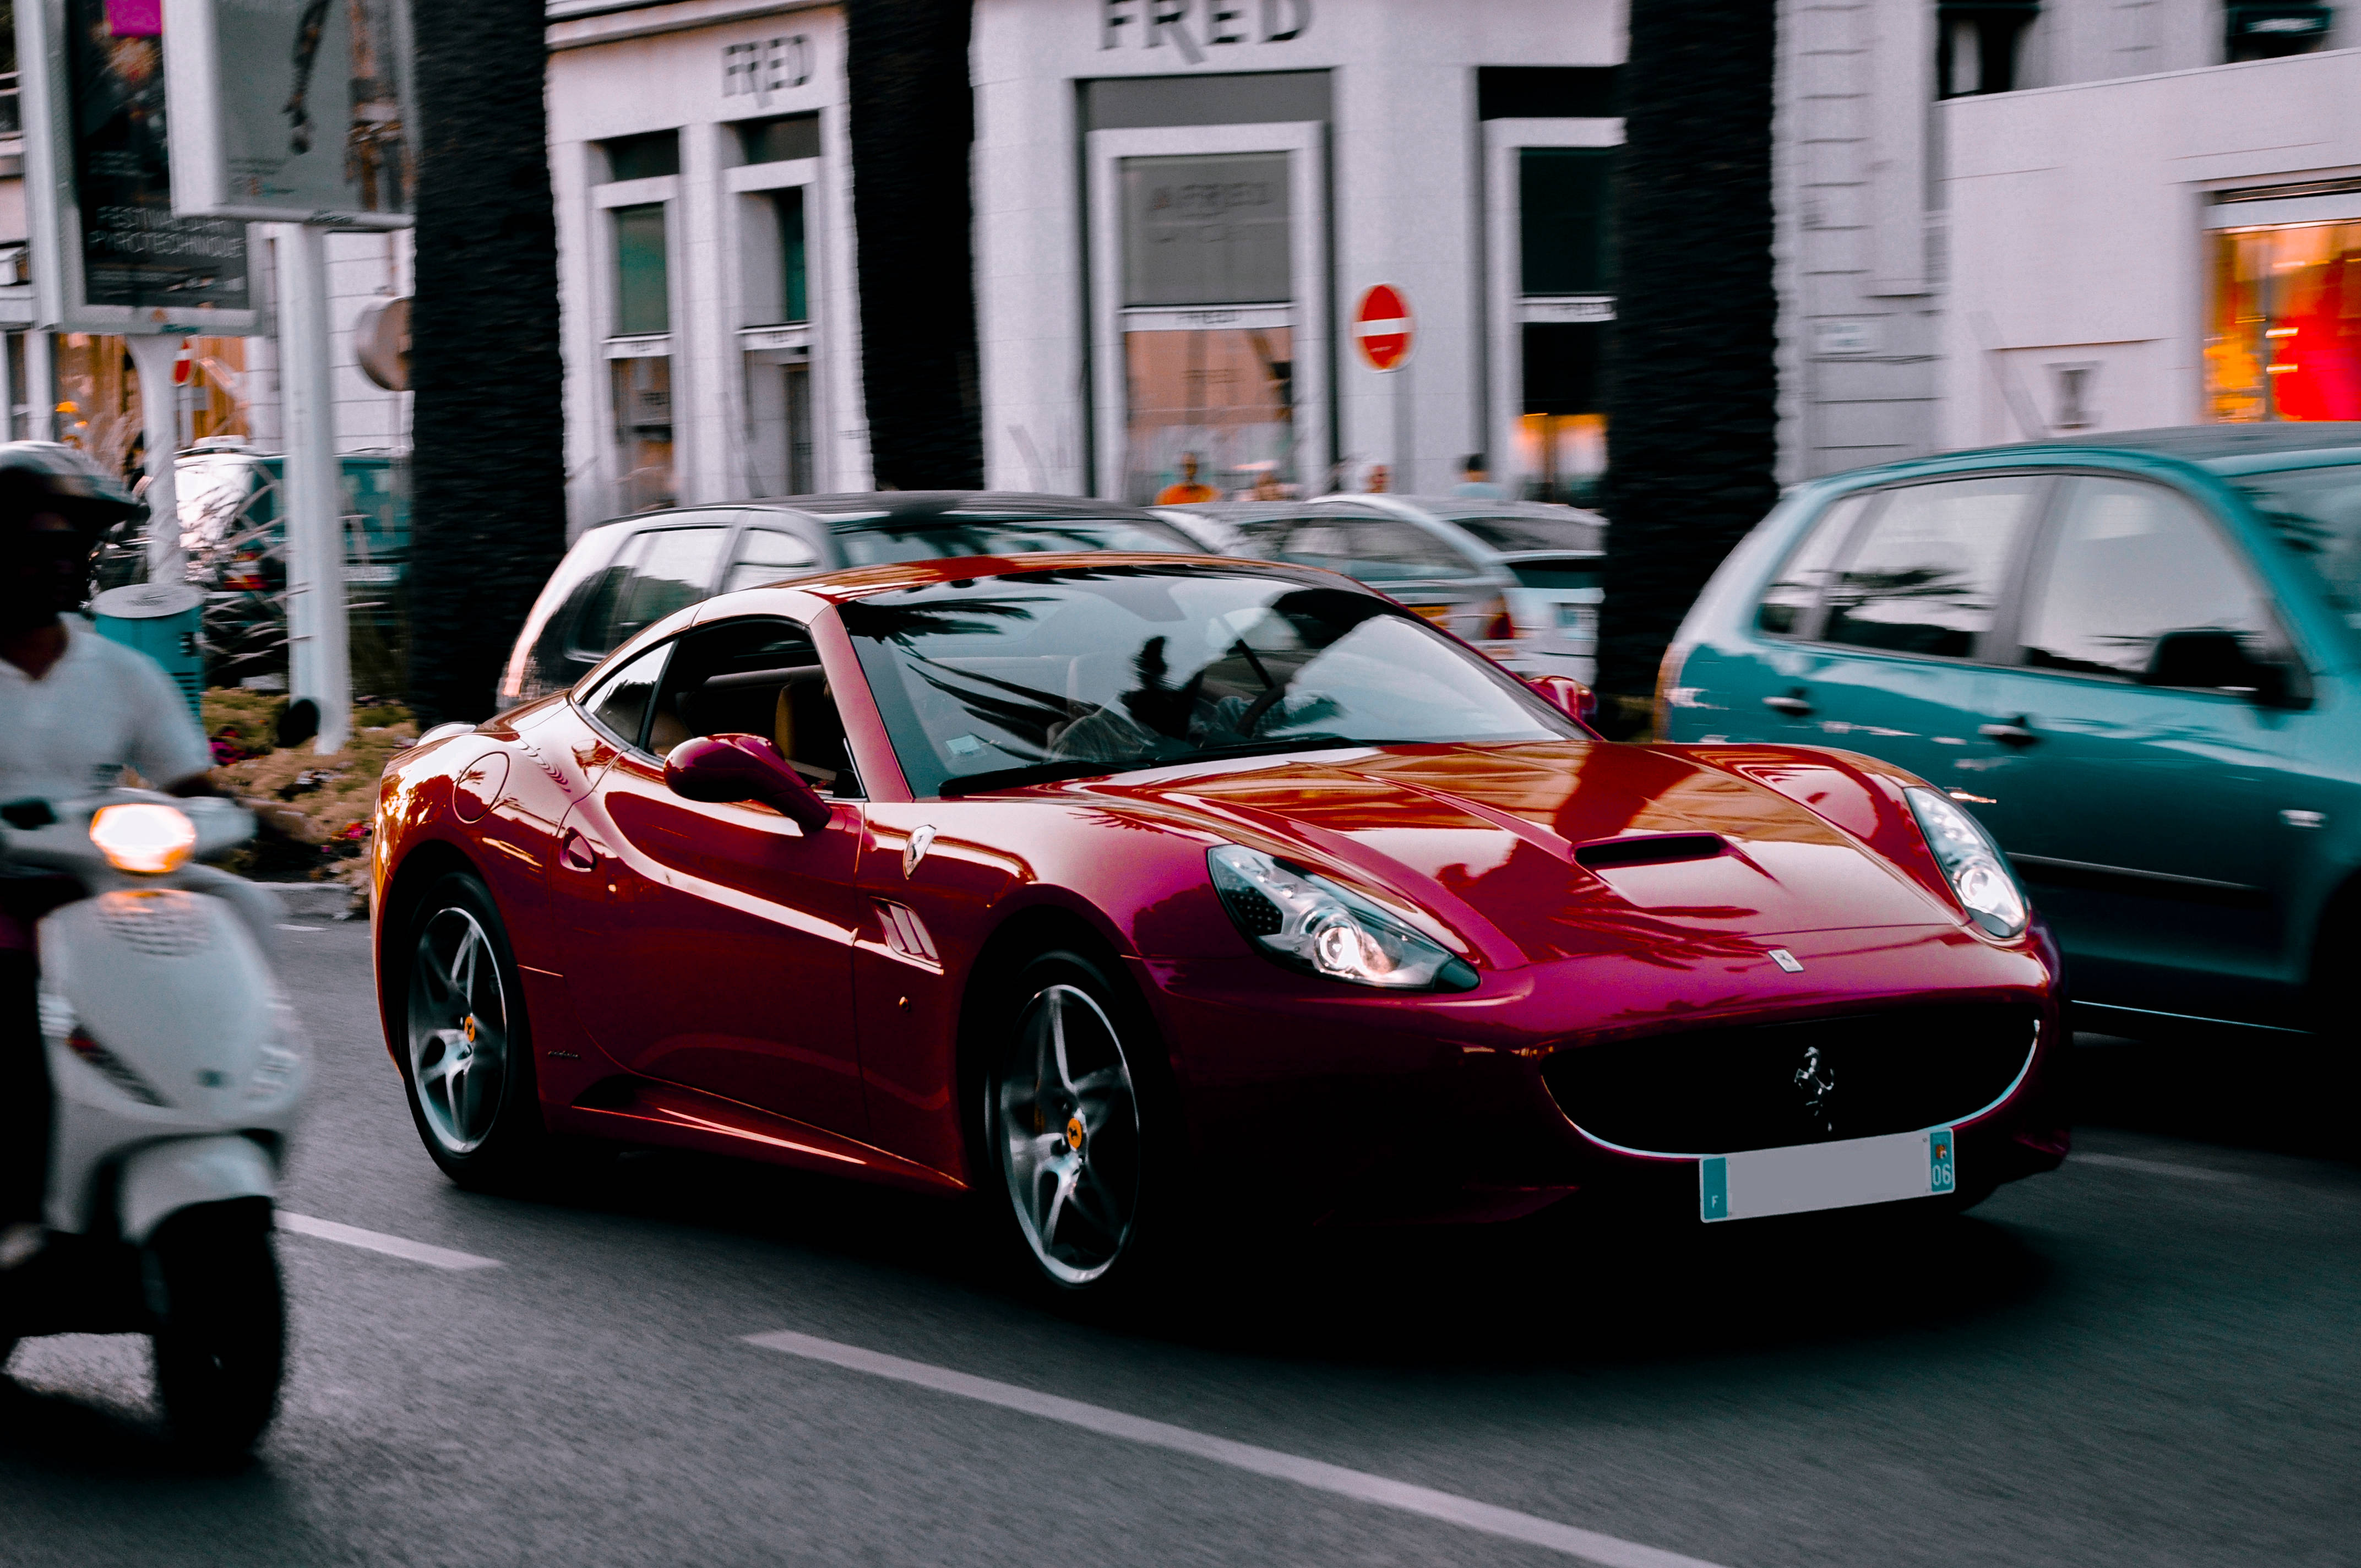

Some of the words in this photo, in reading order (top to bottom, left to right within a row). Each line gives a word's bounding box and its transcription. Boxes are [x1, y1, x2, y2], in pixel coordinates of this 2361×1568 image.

[1098, 0, 1314, 64] FRED
[722, 34, 817, 108] FRED
[1933, 1164, 1951, 1185] 06
[1712, 1195, 1718, 1208] F
